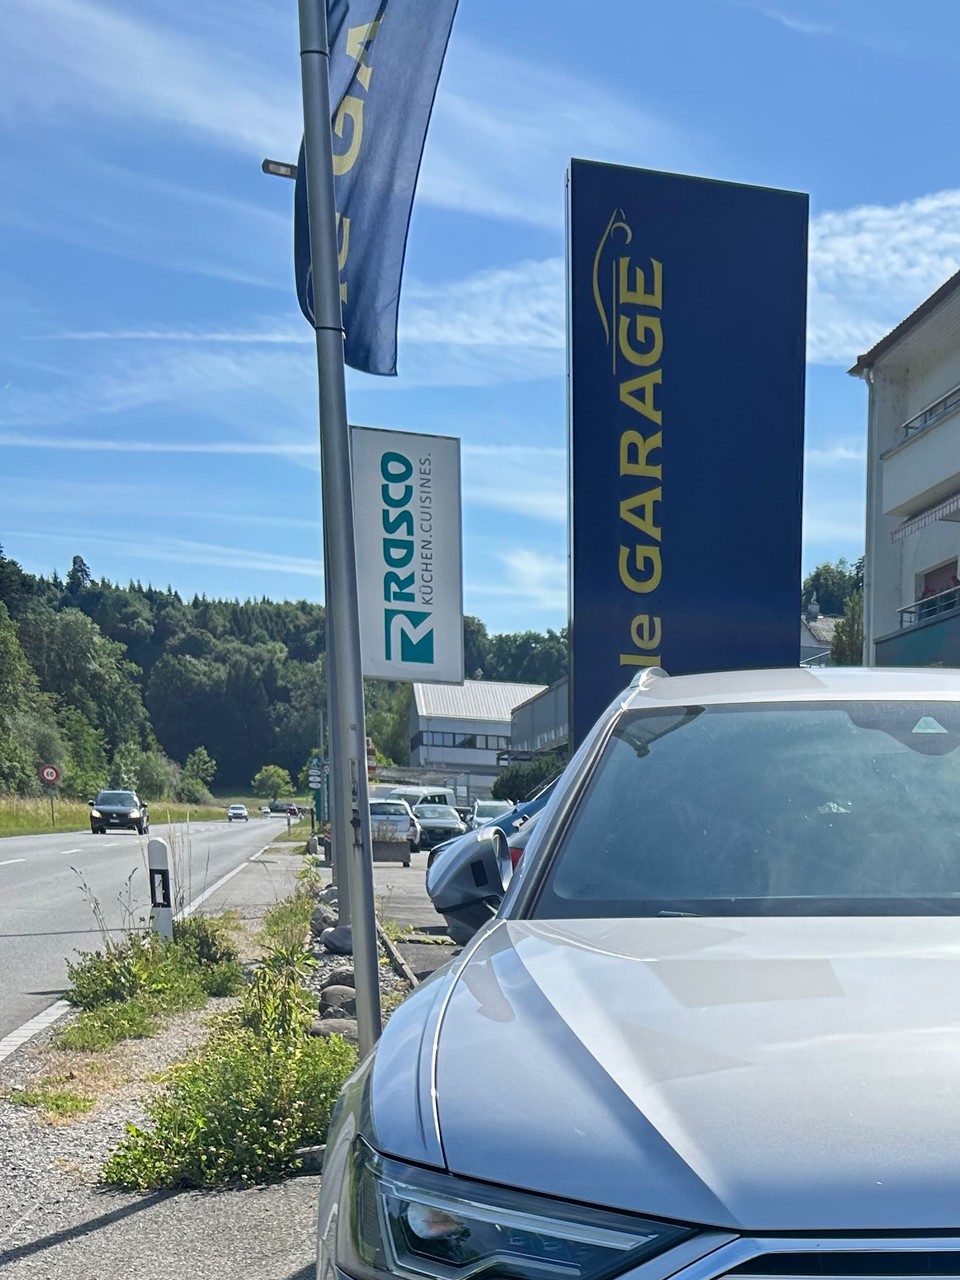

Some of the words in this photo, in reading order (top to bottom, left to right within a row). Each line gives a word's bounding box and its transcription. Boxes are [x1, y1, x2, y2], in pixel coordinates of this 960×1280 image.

[618, 256, 664, 594] GARAGE
[419, 452, 434, 606] KÜCHEN.CUISINES.
[619, 613, 663, 667] le
